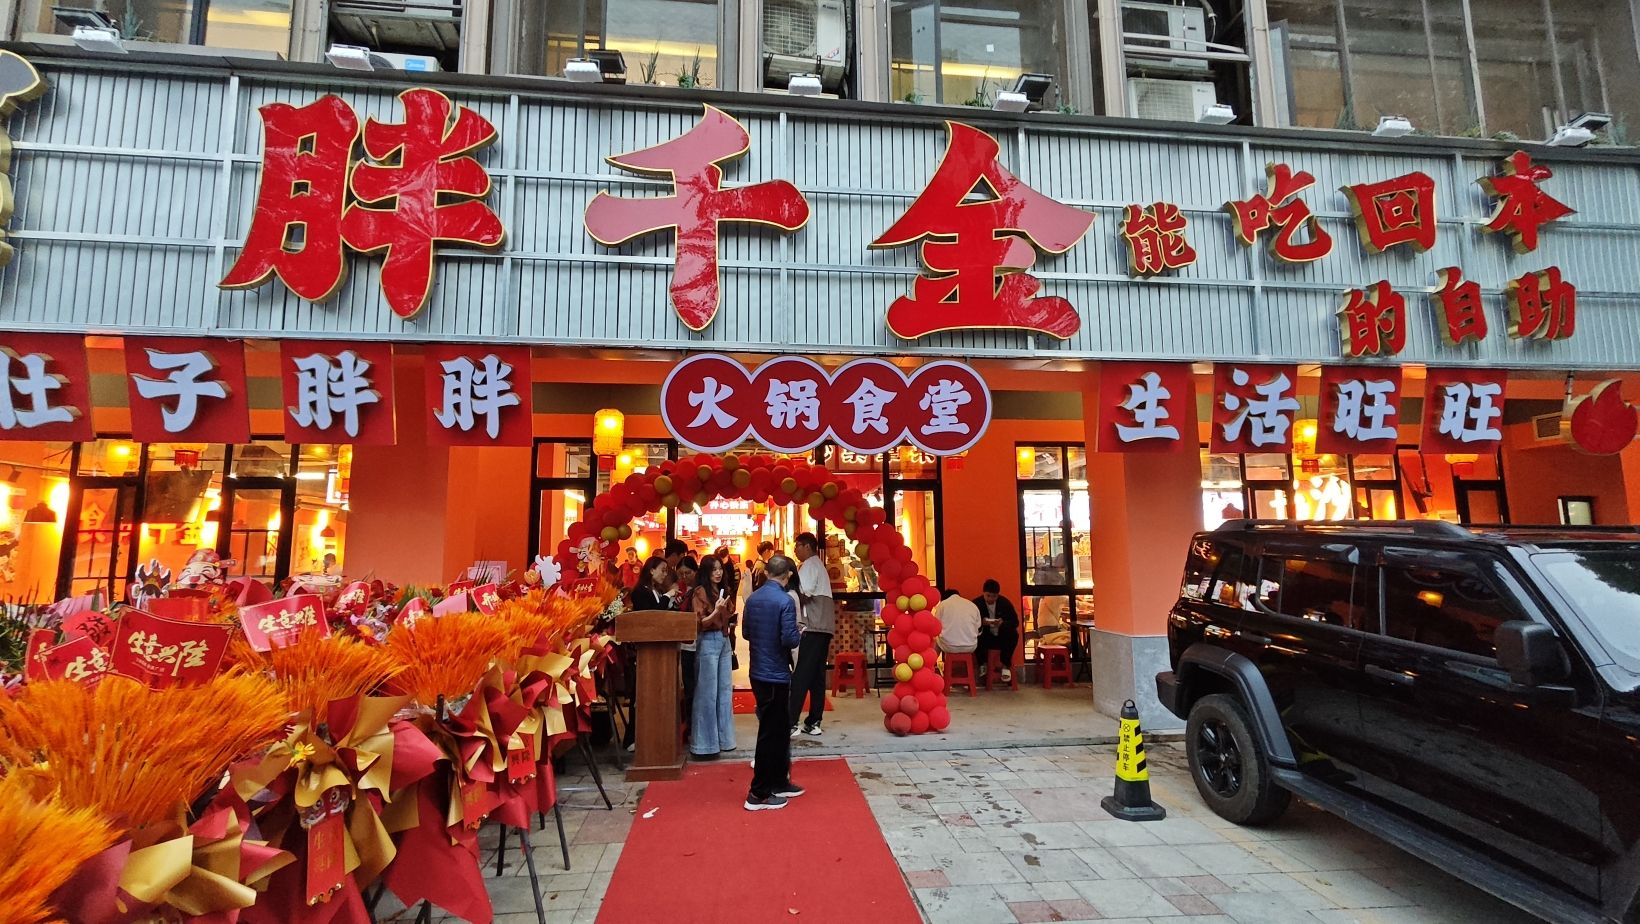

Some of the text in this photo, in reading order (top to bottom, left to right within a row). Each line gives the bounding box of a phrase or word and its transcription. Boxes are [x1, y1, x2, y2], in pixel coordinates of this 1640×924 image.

[218, 88, 1097, 341] 胖千金
[1119, 150, 1577, 277] 能吃回本
[1336, 265, 1577, 357] 的自助
[687, 377, 973, 437] 火锅食堂
[1115, 368, 1505, 447] 生活旺旺
[128, 631, 210, 677] 生意兴隆
[1122, 734, 1131, 771] 禁止停车
